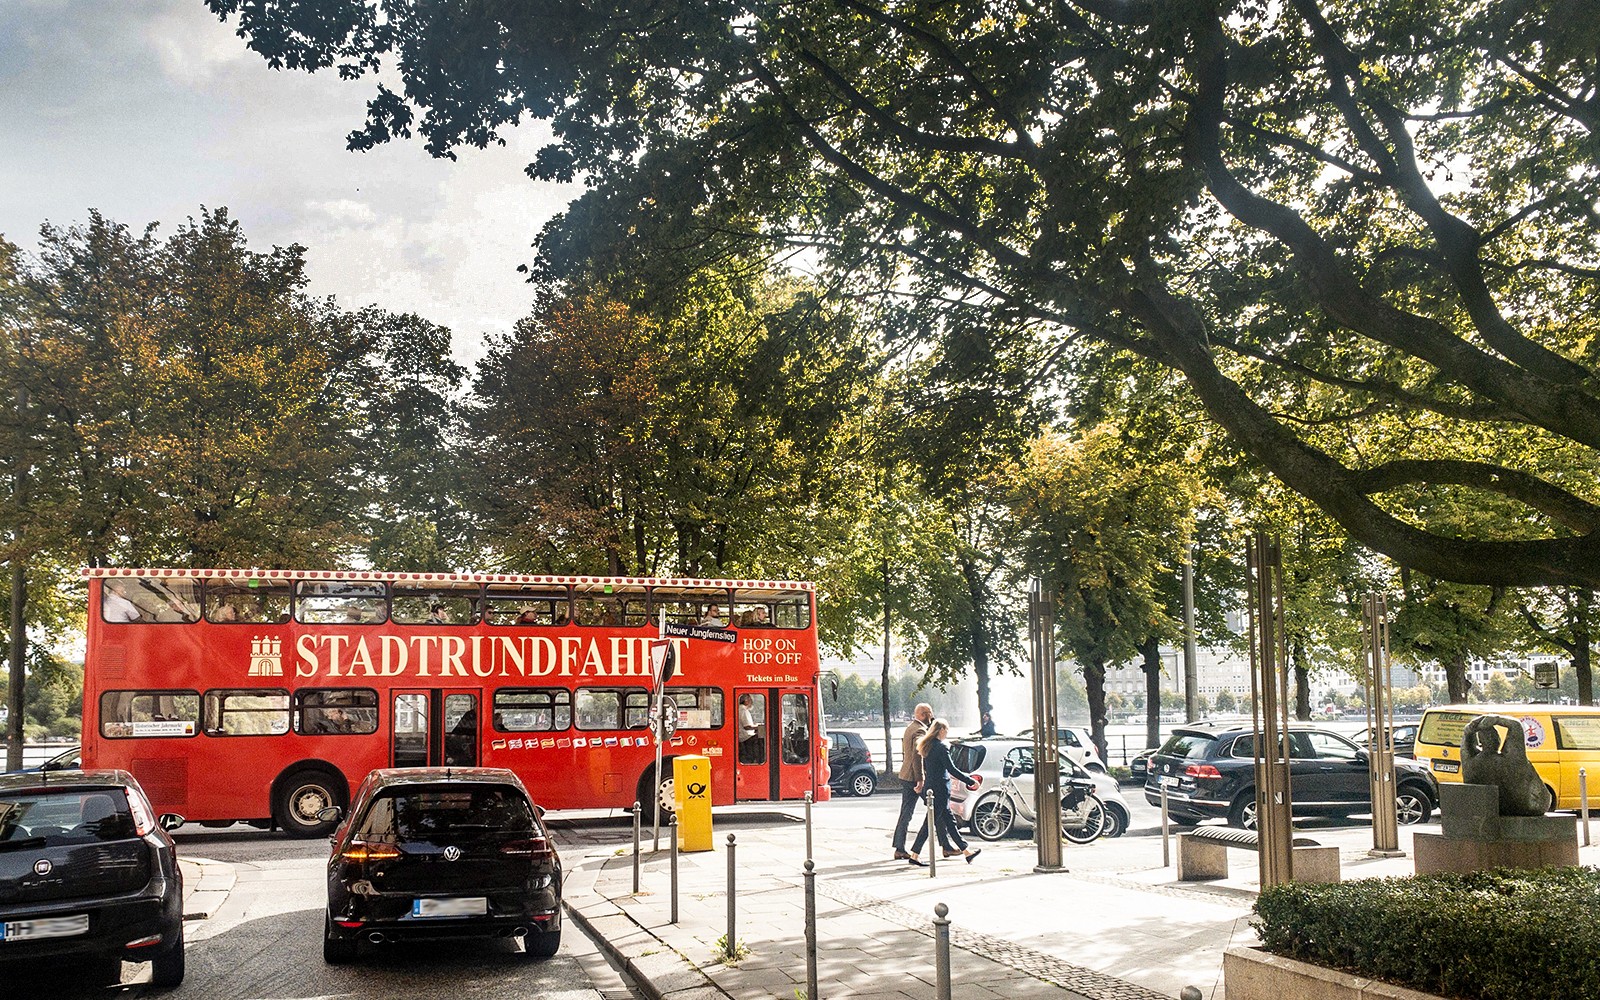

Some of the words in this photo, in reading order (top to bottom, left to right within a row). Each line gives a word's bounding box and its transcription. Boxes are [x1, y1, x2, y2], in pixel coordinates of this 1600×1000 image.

[666, 624, 688, 636] Neuer
[690, 627, 736, 643] Jungfernstieg
[743, 638, 772, 651] HOP
[775, 638, 796, 651] ON
[743, 652, 773, 664] HOP
[775, 652, 802, 664] OFF
[747, 674, 773, 682] Tickets
[774, 674, 783, 682] im
[785, 674, 798, 682] Bus
